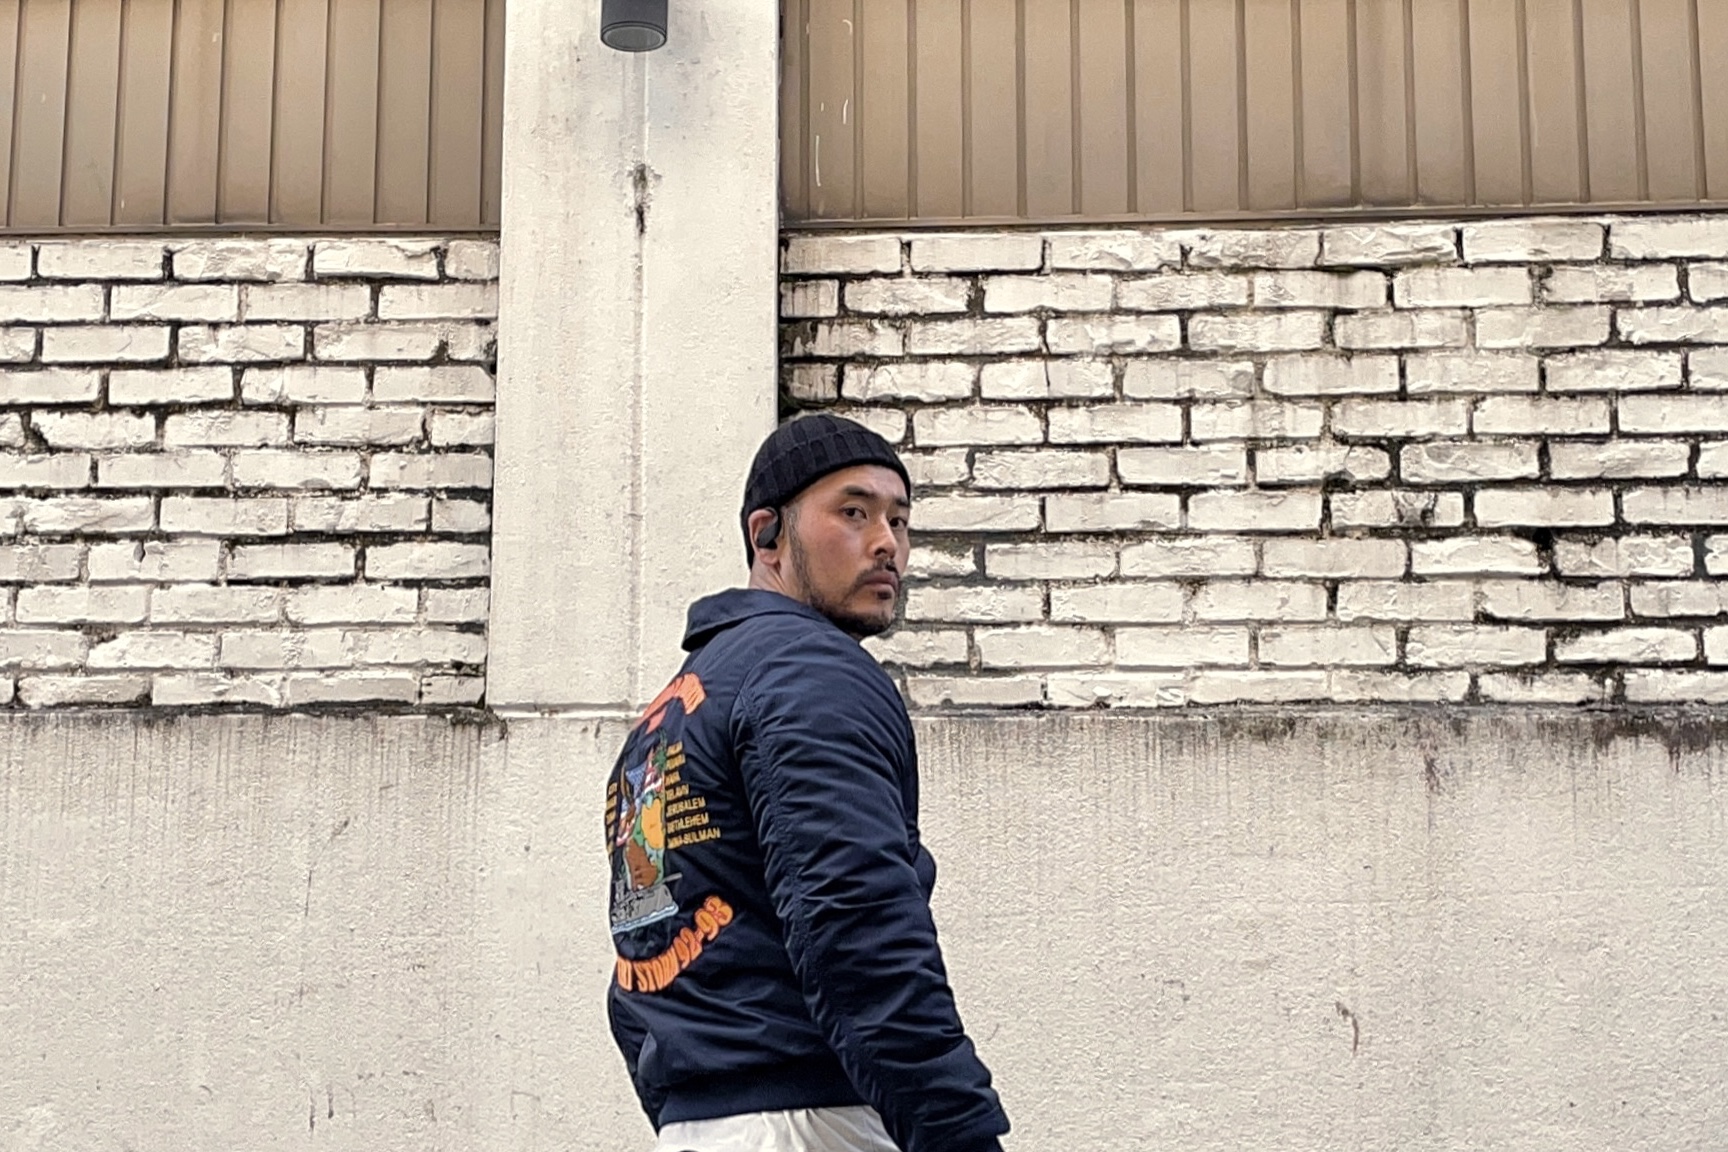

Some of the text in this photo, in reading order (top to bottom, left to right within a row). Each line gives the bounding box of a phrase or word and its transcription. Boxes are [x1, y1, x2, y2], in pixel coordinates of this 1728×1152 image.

[666, 796, 706, 818] JERUSALEM
[667, 811, 709, 834] BETHLEHEM
[674, 895, 733, 969] 92-93
